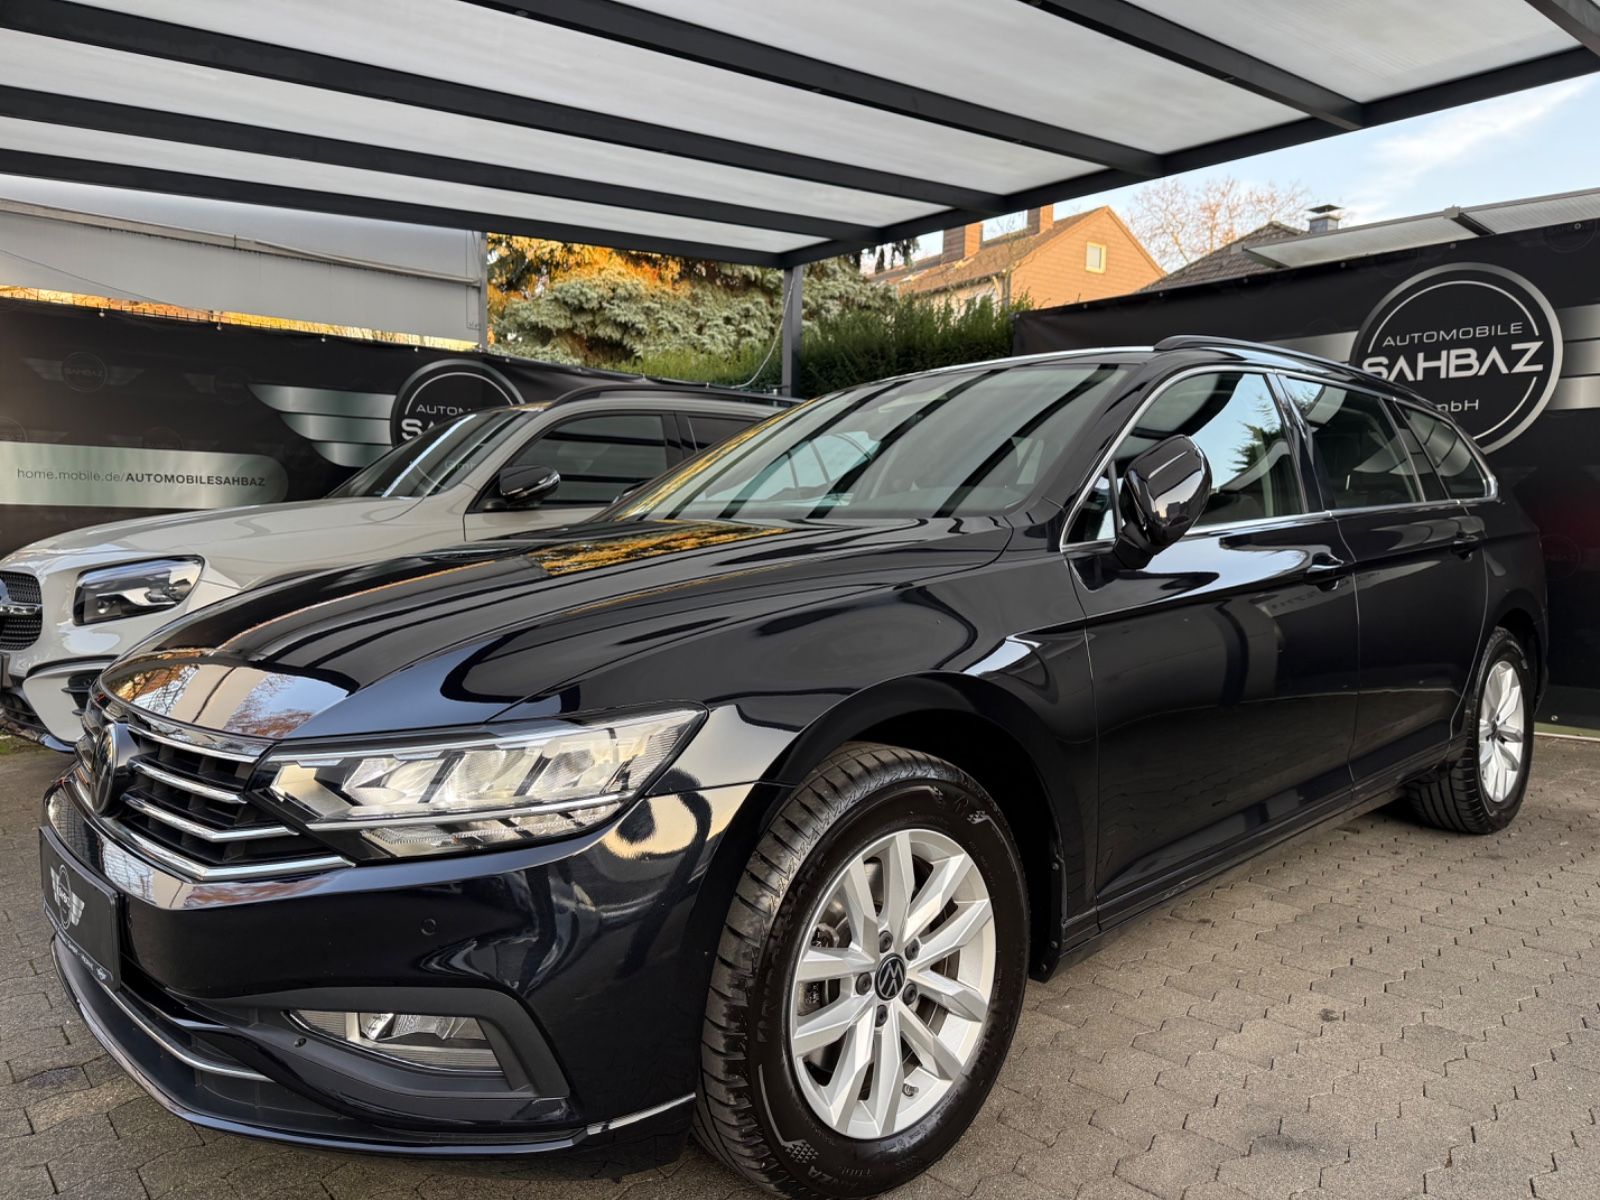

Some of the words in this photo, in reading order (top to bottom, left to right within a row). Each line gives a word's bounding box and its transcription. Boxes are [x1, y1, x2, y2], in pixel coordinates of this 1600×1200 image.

[1382, 322, 1523, 347] AUTOMOBILE
[1362, 341, 1544, 382] SAHBAZ
[17, 467, 266, 487] home.mobile.de/AUTOMOBILESAHBAZ
